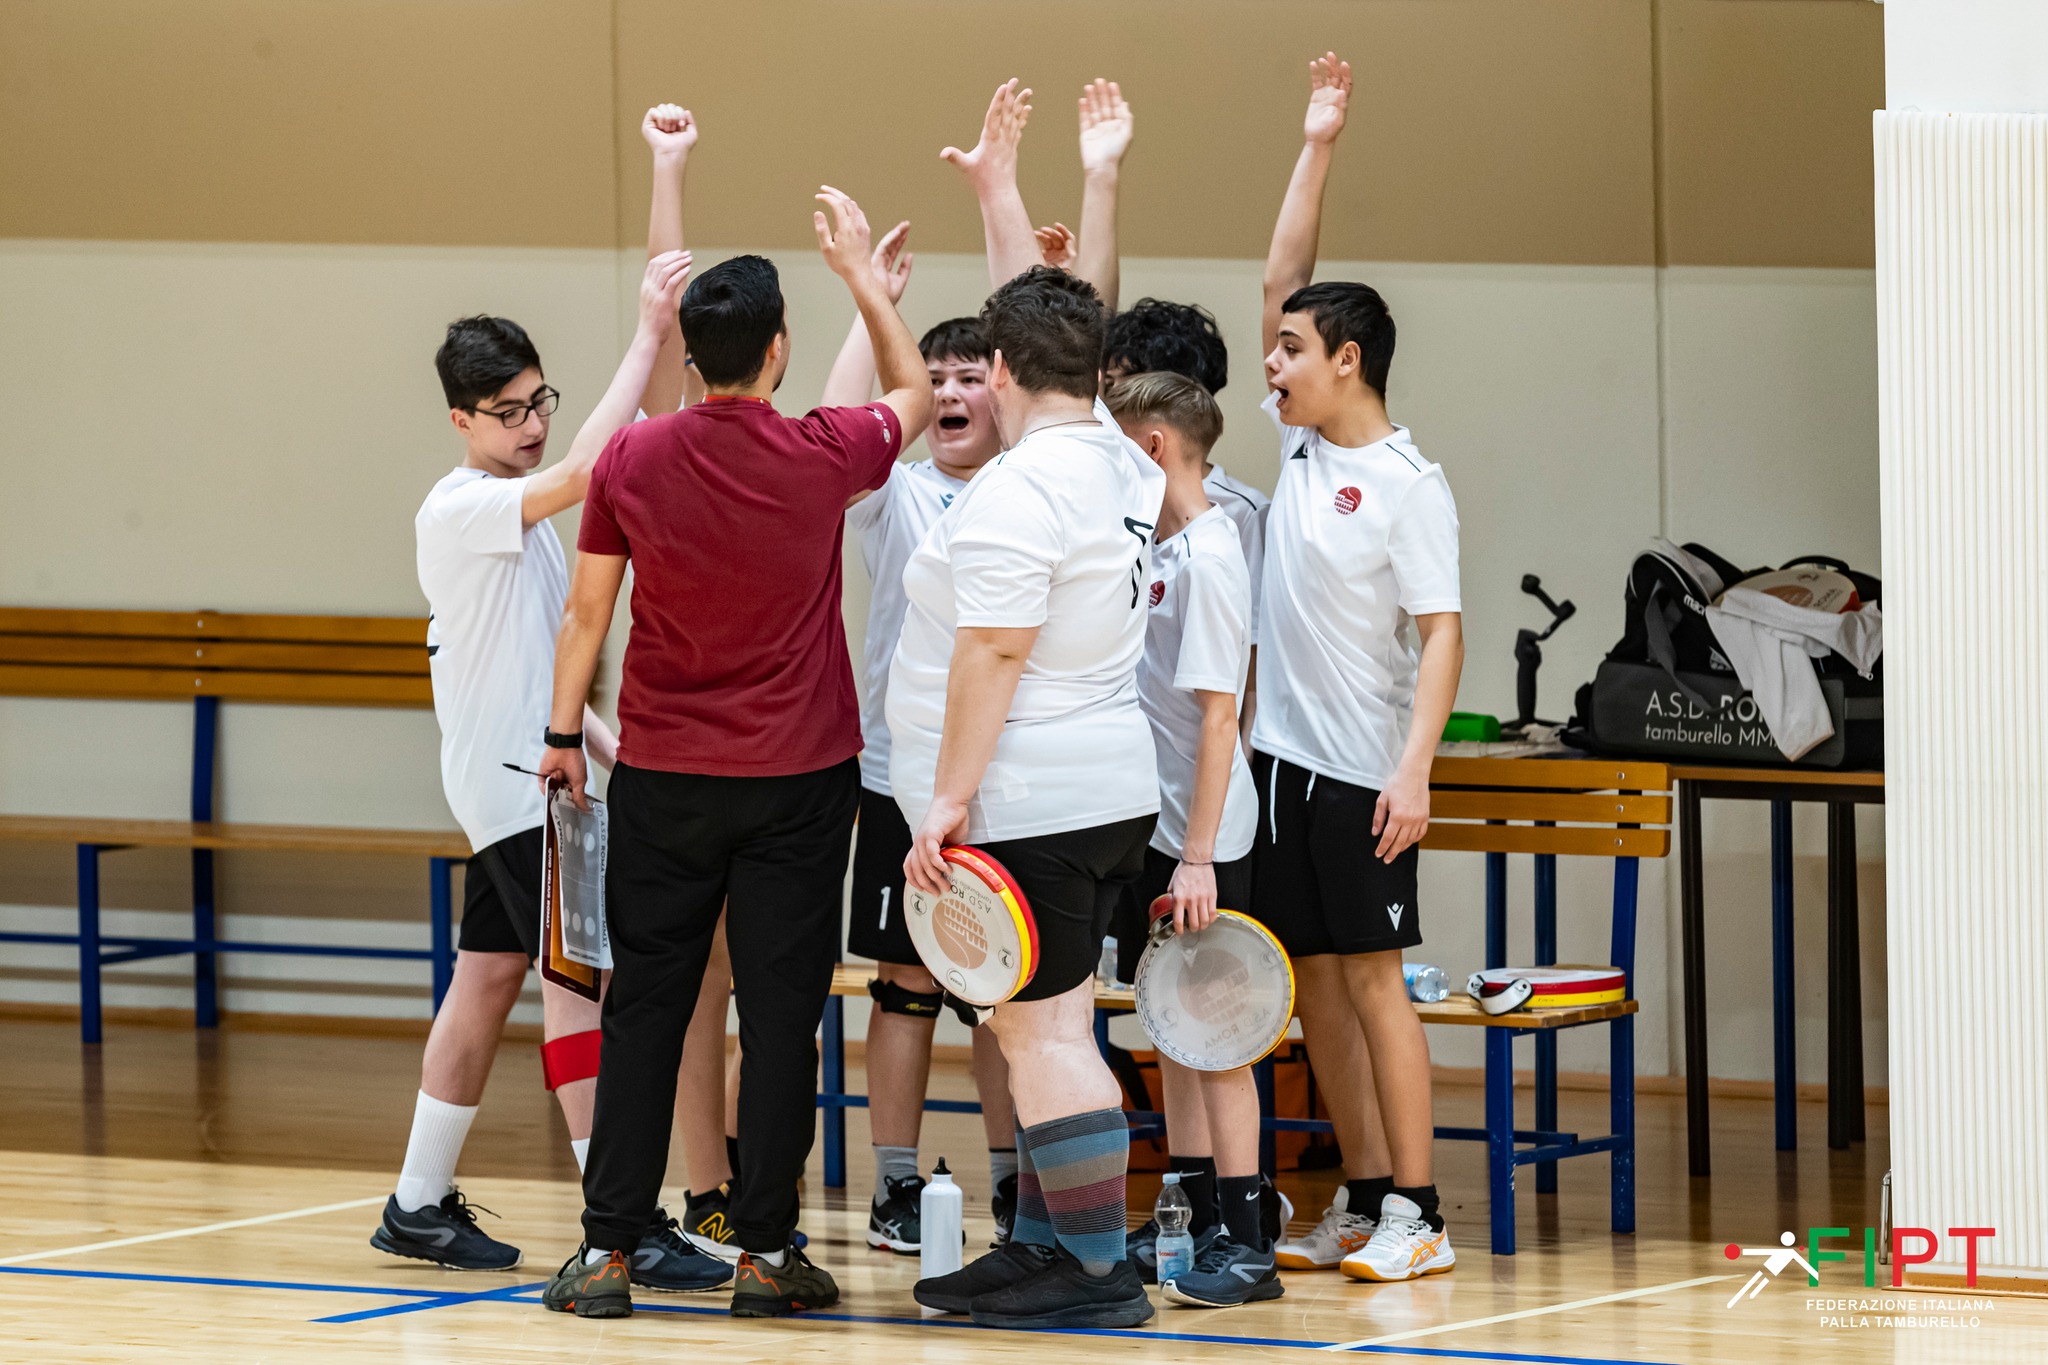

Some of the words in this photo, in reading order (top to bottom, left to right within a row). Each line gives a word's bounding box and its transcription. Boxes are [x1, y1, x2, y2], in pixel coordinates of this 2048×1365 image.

[1720, 694, 1763, 723] RO
[1645, 720, 1732, 745] tamburello
[1738, 726, 1777, 748] MM
[601, 920, 609, 948] MMXX
